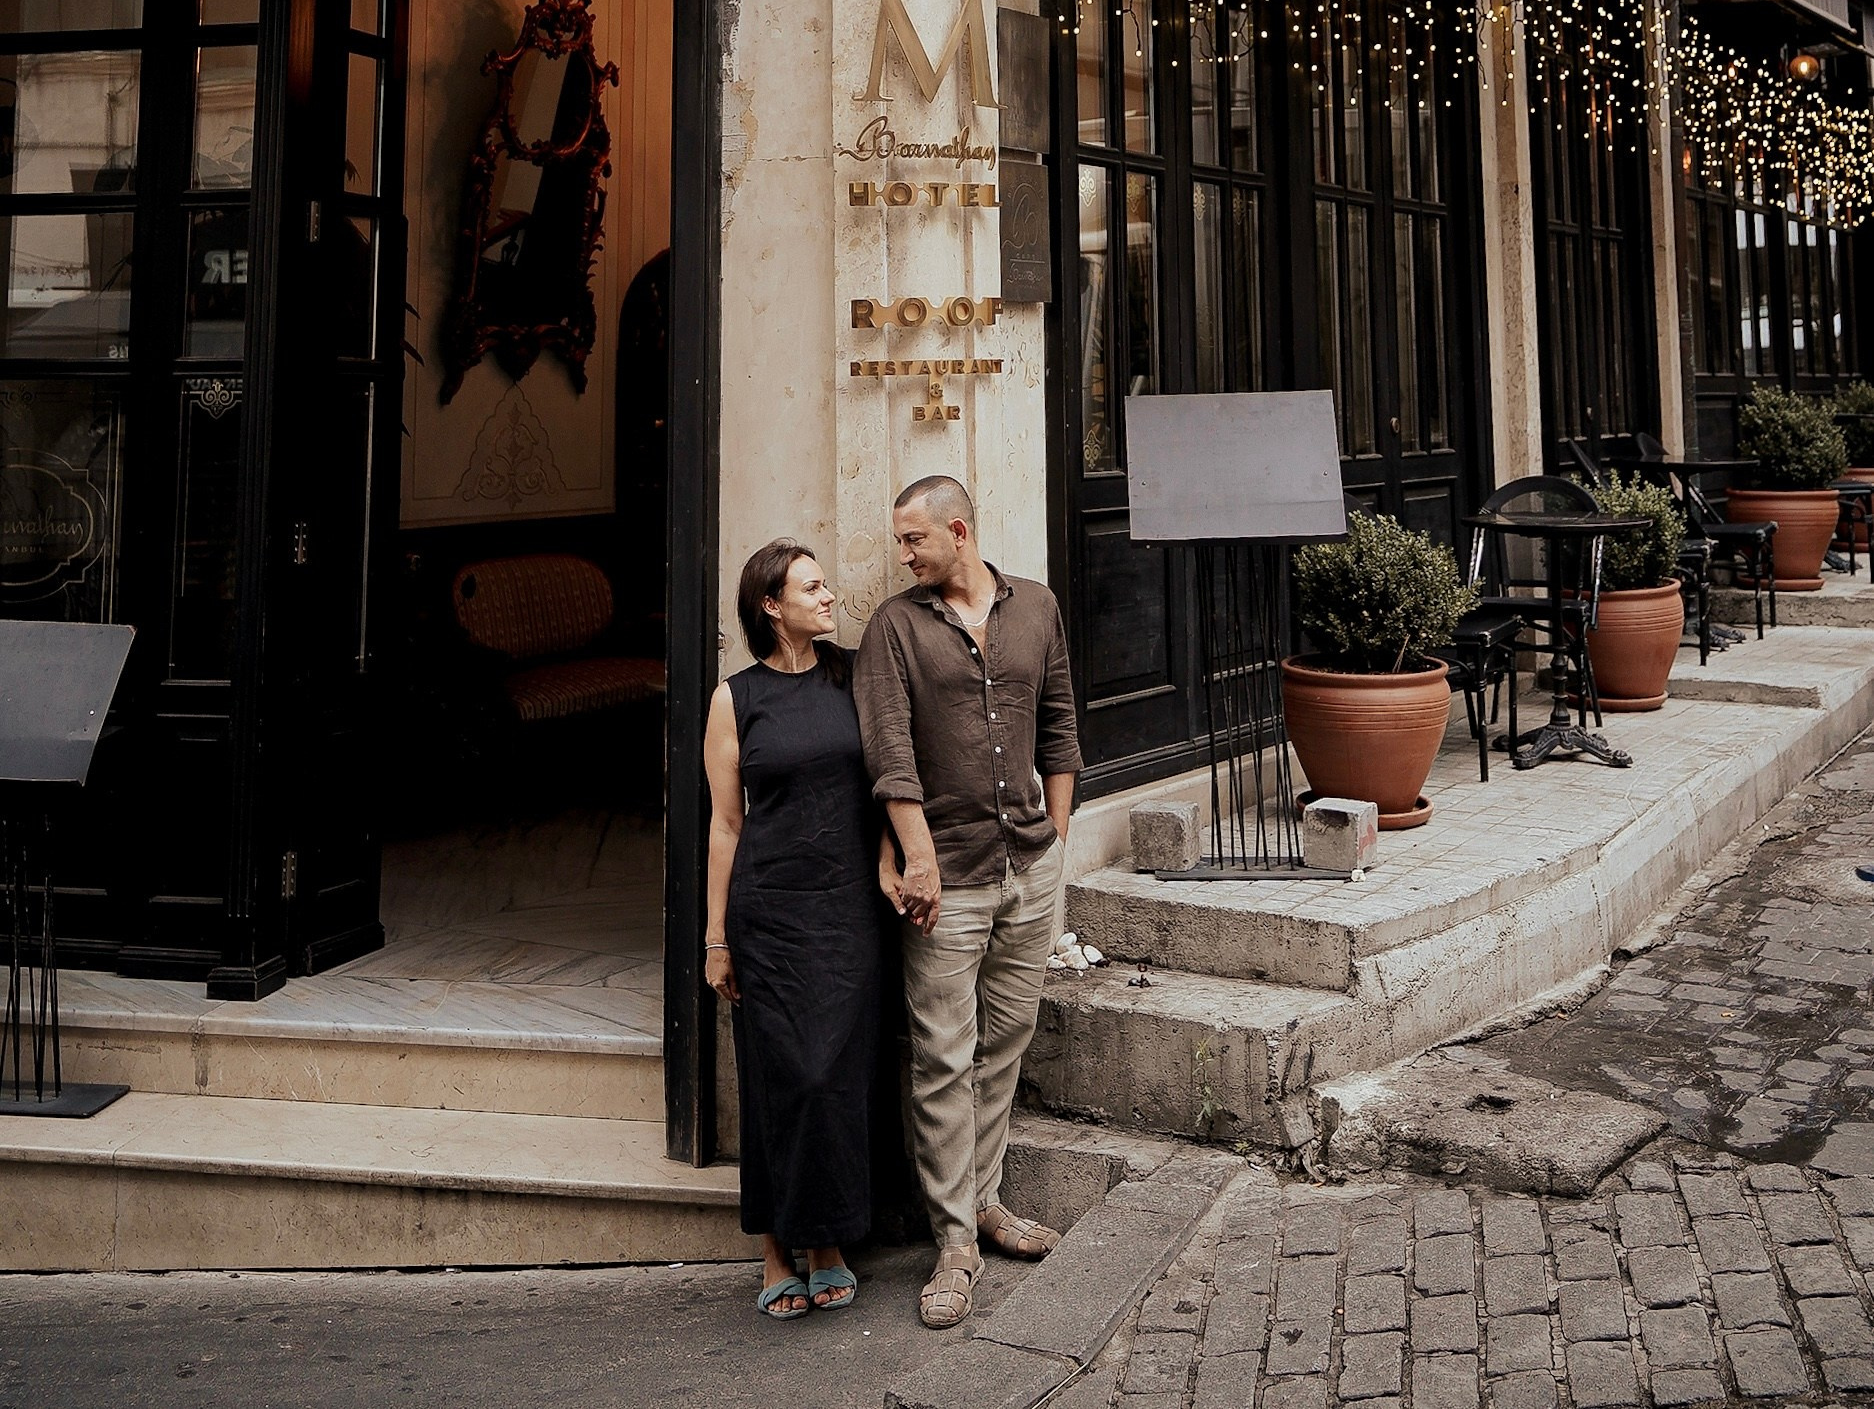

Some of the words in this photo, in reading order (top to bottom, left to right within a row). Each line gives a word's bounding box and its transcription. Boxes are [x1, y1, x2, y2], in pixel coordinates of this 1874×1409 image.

[838, 115, 997, 171] Barnathan
[850, 182, 1003, 207] HOTEL
[851, 296, 1004, 329] ROOF
[850, 359, 1004, 377] RESTAURANT
[930, 382, 944, 398] &
[912, 405, 961, 422] BAR
